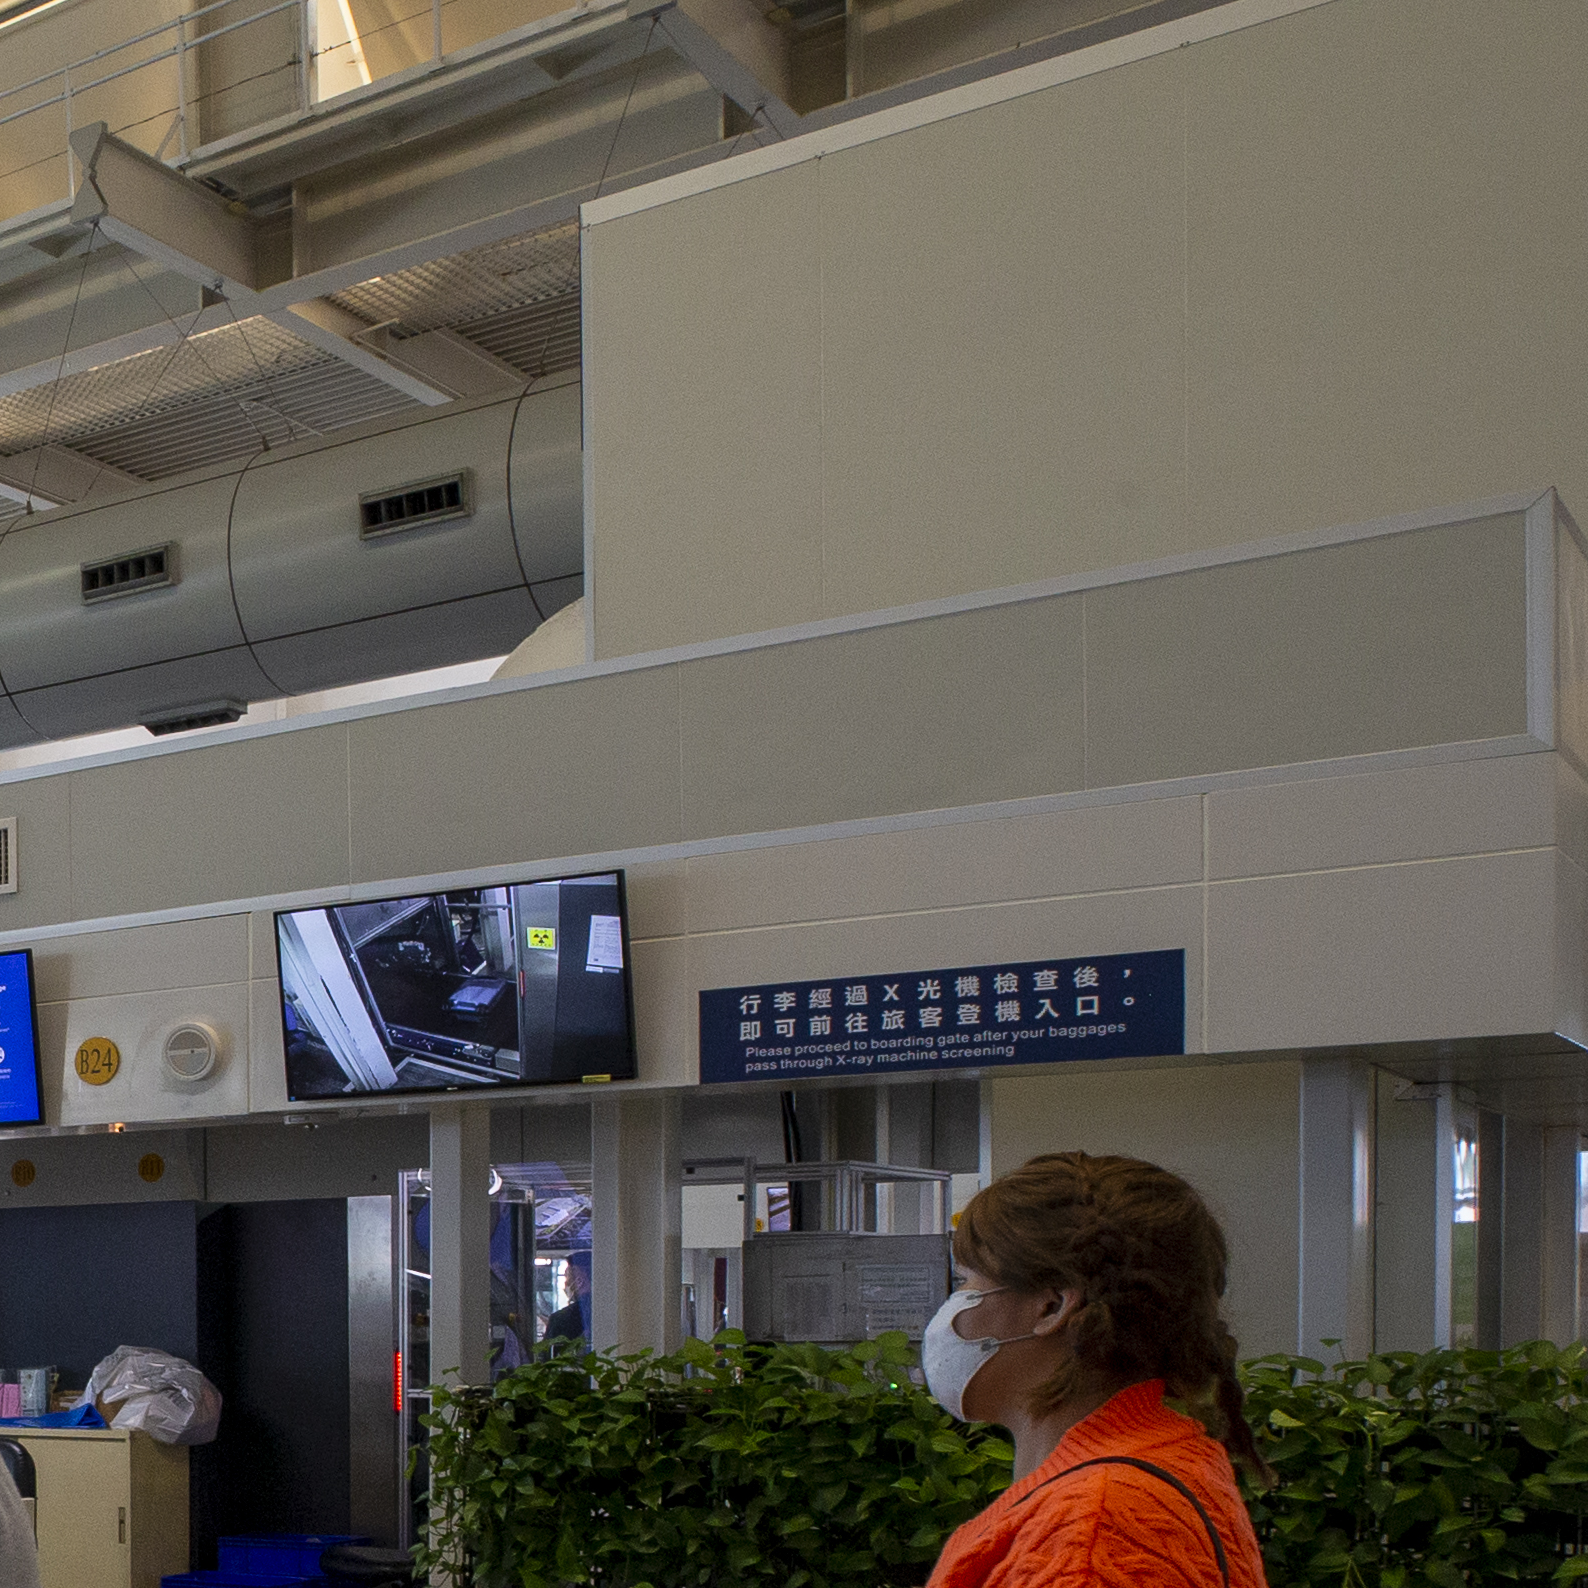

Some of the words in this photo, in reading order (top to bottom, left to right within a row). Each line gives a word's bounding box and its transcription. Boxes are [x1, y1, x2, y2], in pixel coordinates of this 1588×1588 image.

[739, 995, 1135, 1041] 即可前往旅客登機入口。
[745, 1046, 792, 1058] Please
[794, 1040, 851, 1057] proceed
[853, 1039, 868, 1051] to
[871, 1035, 934, 1050] boarding
[937, 1032, 970, 1048] gate
[973, 1030, 1007, 1043] after
[1011, 1028, 1045, 1042] your
[1049, 1023, 1126, 1038] baggages
[80, 1047, 113, 1075] B24
[745, 1062, 778, 1074] pass
[780, 1056, 833, 1070] through
[835, 1054, 874, 1067] X-ray
[877, 1050, 938, 1063] machine
[941, 1044, 1015, 1060] screening
